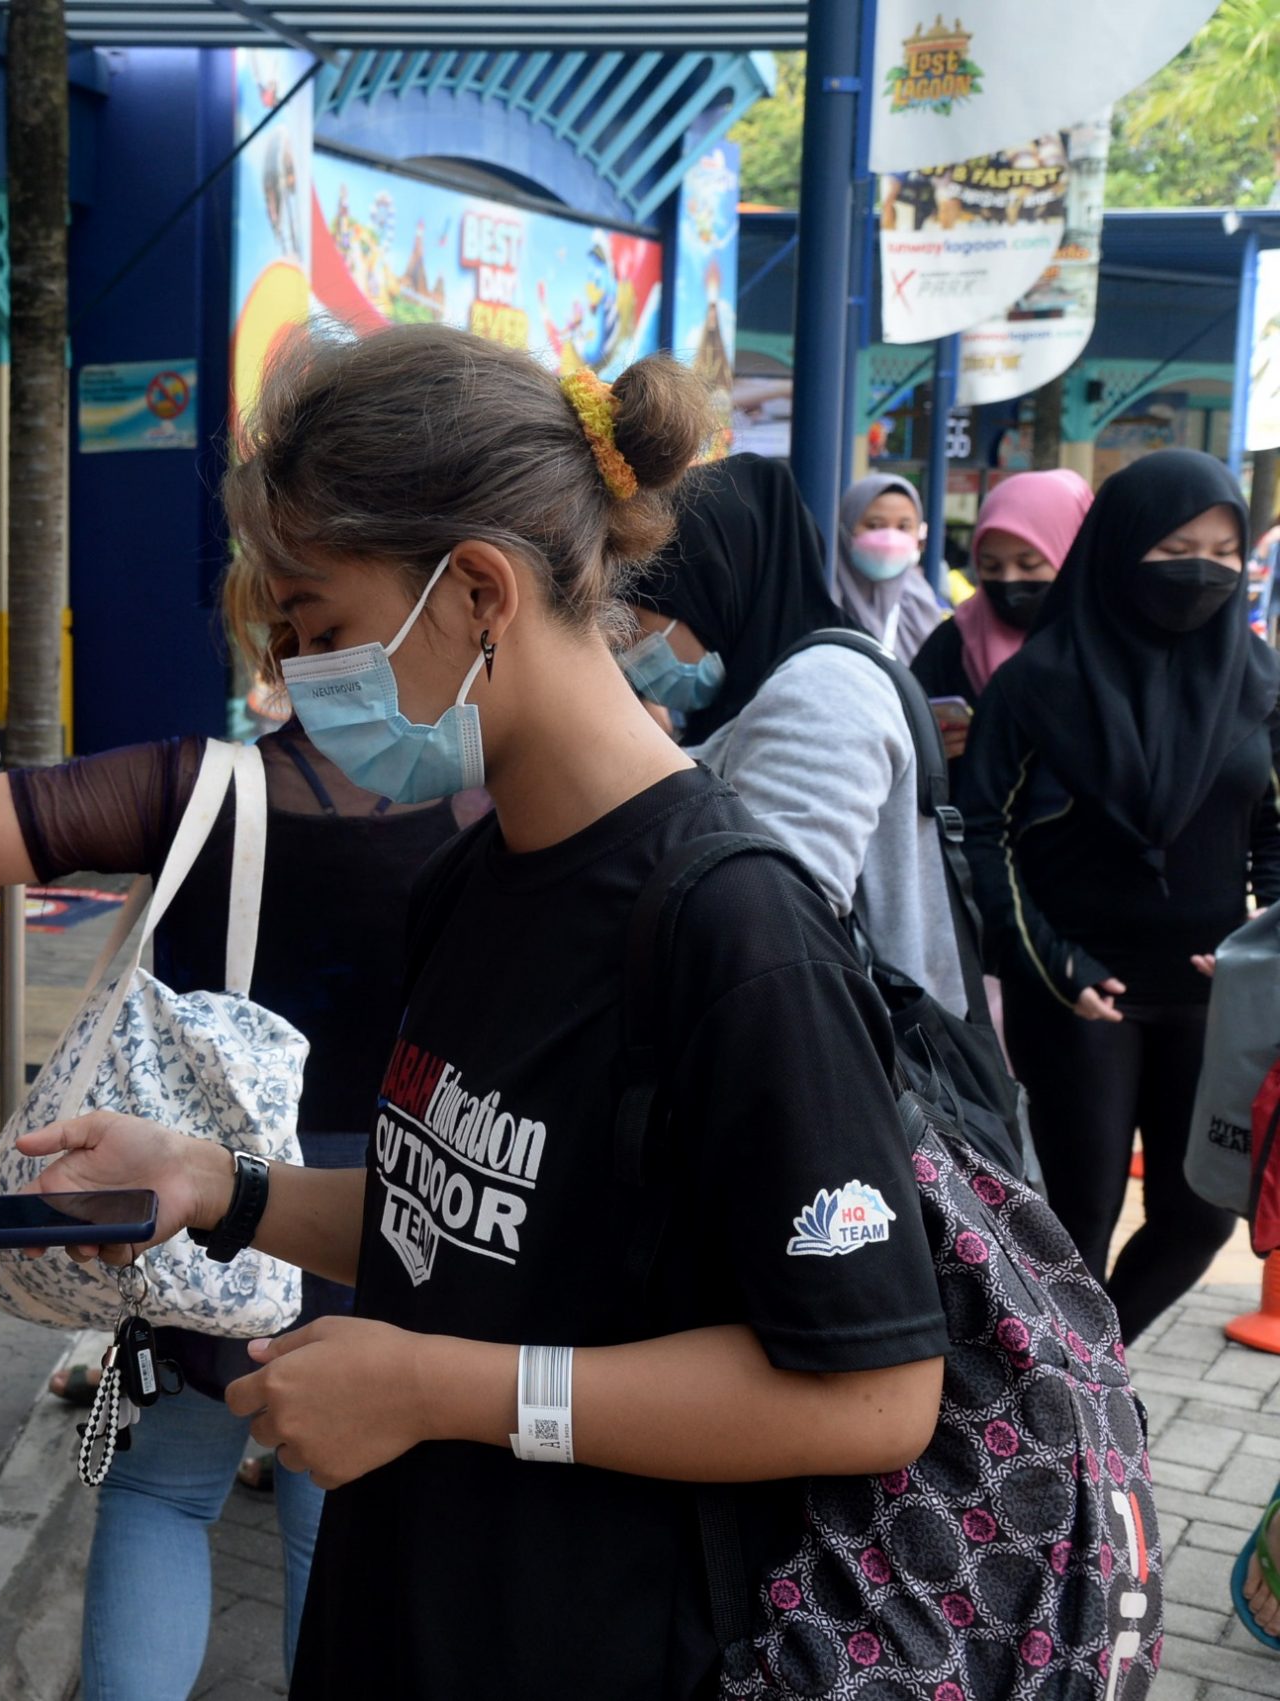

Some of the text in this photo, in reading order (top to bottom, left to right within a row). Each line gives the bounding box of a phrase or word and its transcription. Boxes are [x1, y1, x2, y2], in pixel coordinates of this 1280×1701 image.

[893, 73, 973, 106] LAGOON
[971, 166, 1064, 190] FASTEST
[460, 211, 522, 272] BEST
[311, 680, 363, 699] NEUTROVIS
[380, 1038, 547, 1182] ABAH Education
[376, 1113, 528, 1253] OUTDOOR
[841, 1206, 866, 1224] HQ
[839, 1223, 886, 1243] TEAM
